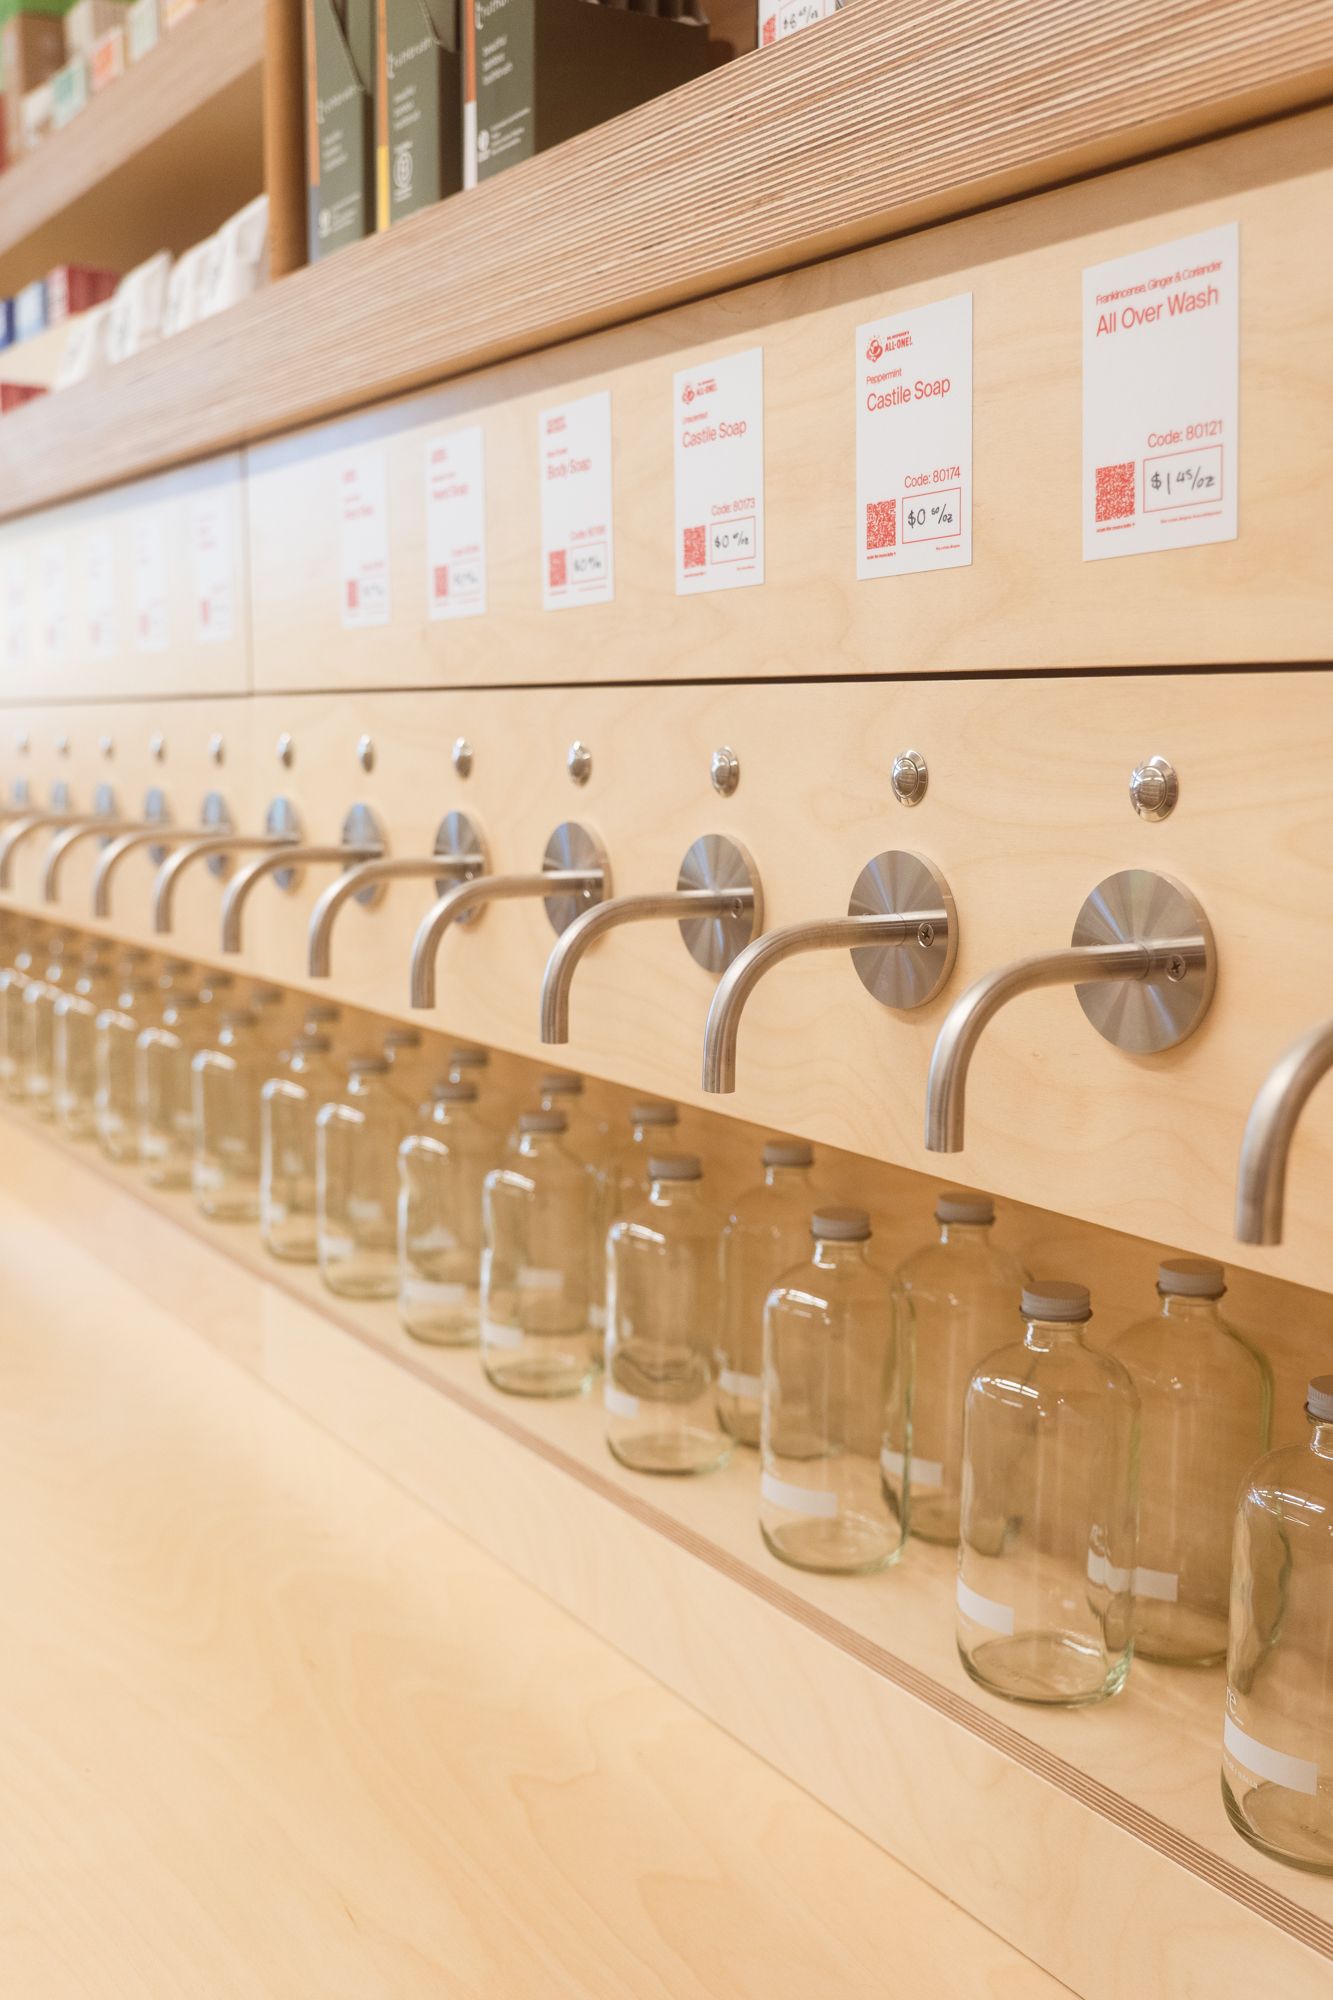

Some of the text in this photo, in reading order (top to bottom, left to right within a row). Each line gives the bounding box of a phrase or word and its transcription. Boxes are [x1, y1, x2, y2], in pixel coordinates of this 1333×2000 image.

[1147, 274, 1174, 291] Ginger
[1174, 271, 1183, 283] &
[1182, 260, 1223, 280] Coriander
[1096, 284, 1219, 337] All Over Wash
[866, 367, 902, 385] Peppermint
[867, 378, 951, 412] Castile Soap
[683, 420, 747, 449] Castile Soap
[1147, 419, 1223, 448] Code: 80121
[904, 466, 961, 489] Code: 80174
[712, 497, 755, 516] Code: 80173
